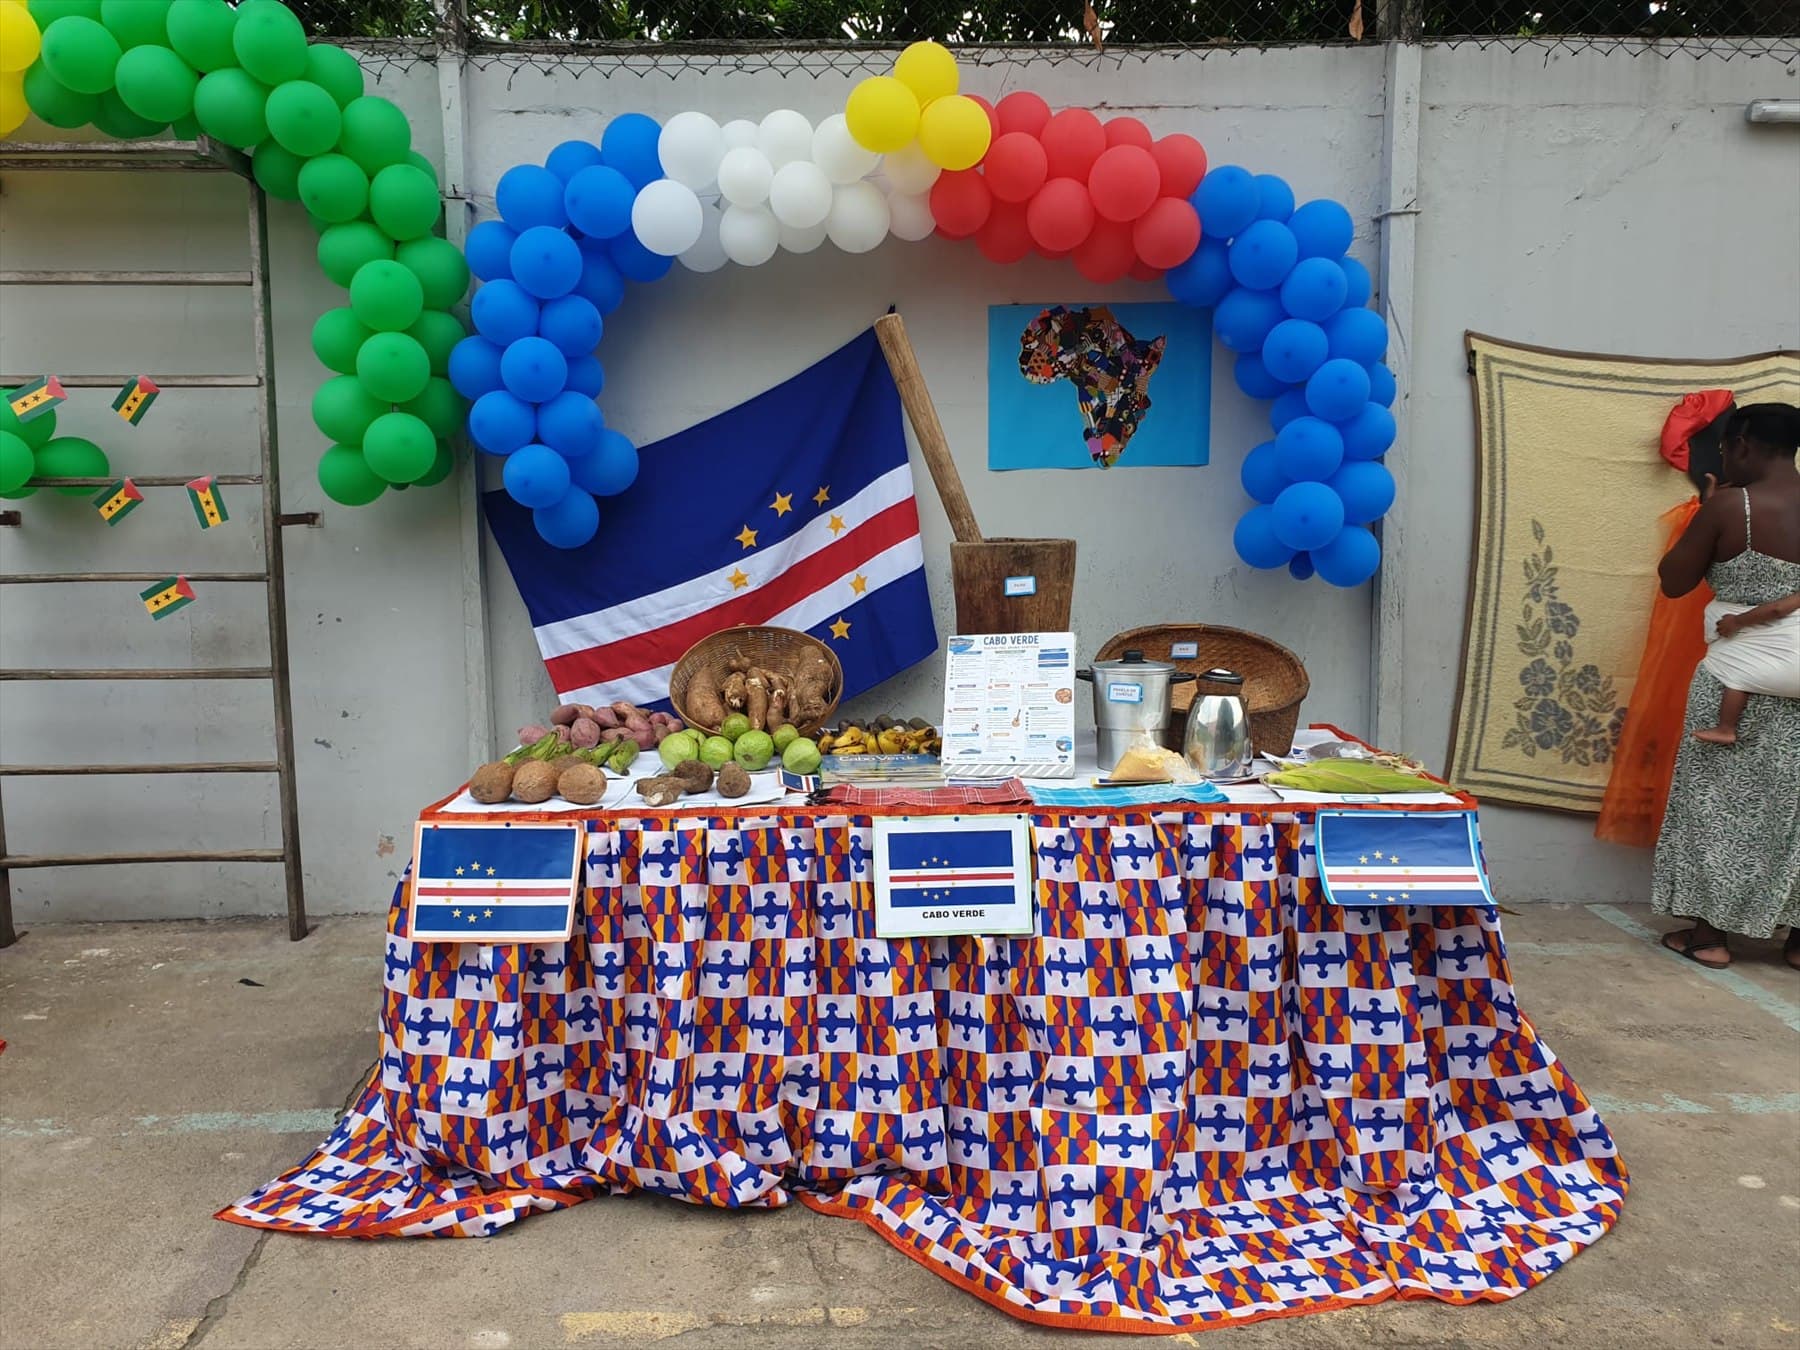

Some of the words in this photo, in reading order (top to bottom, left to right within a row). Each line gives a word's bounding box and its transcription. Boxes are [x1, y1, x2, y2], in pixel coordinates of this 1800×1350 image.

[983, 636, 1007, 646] CABO
[1010, 635, 1040, 645] VERDE
[922, 911, 949, 919] CABO
[952, 909, 985, 917] VERDE
